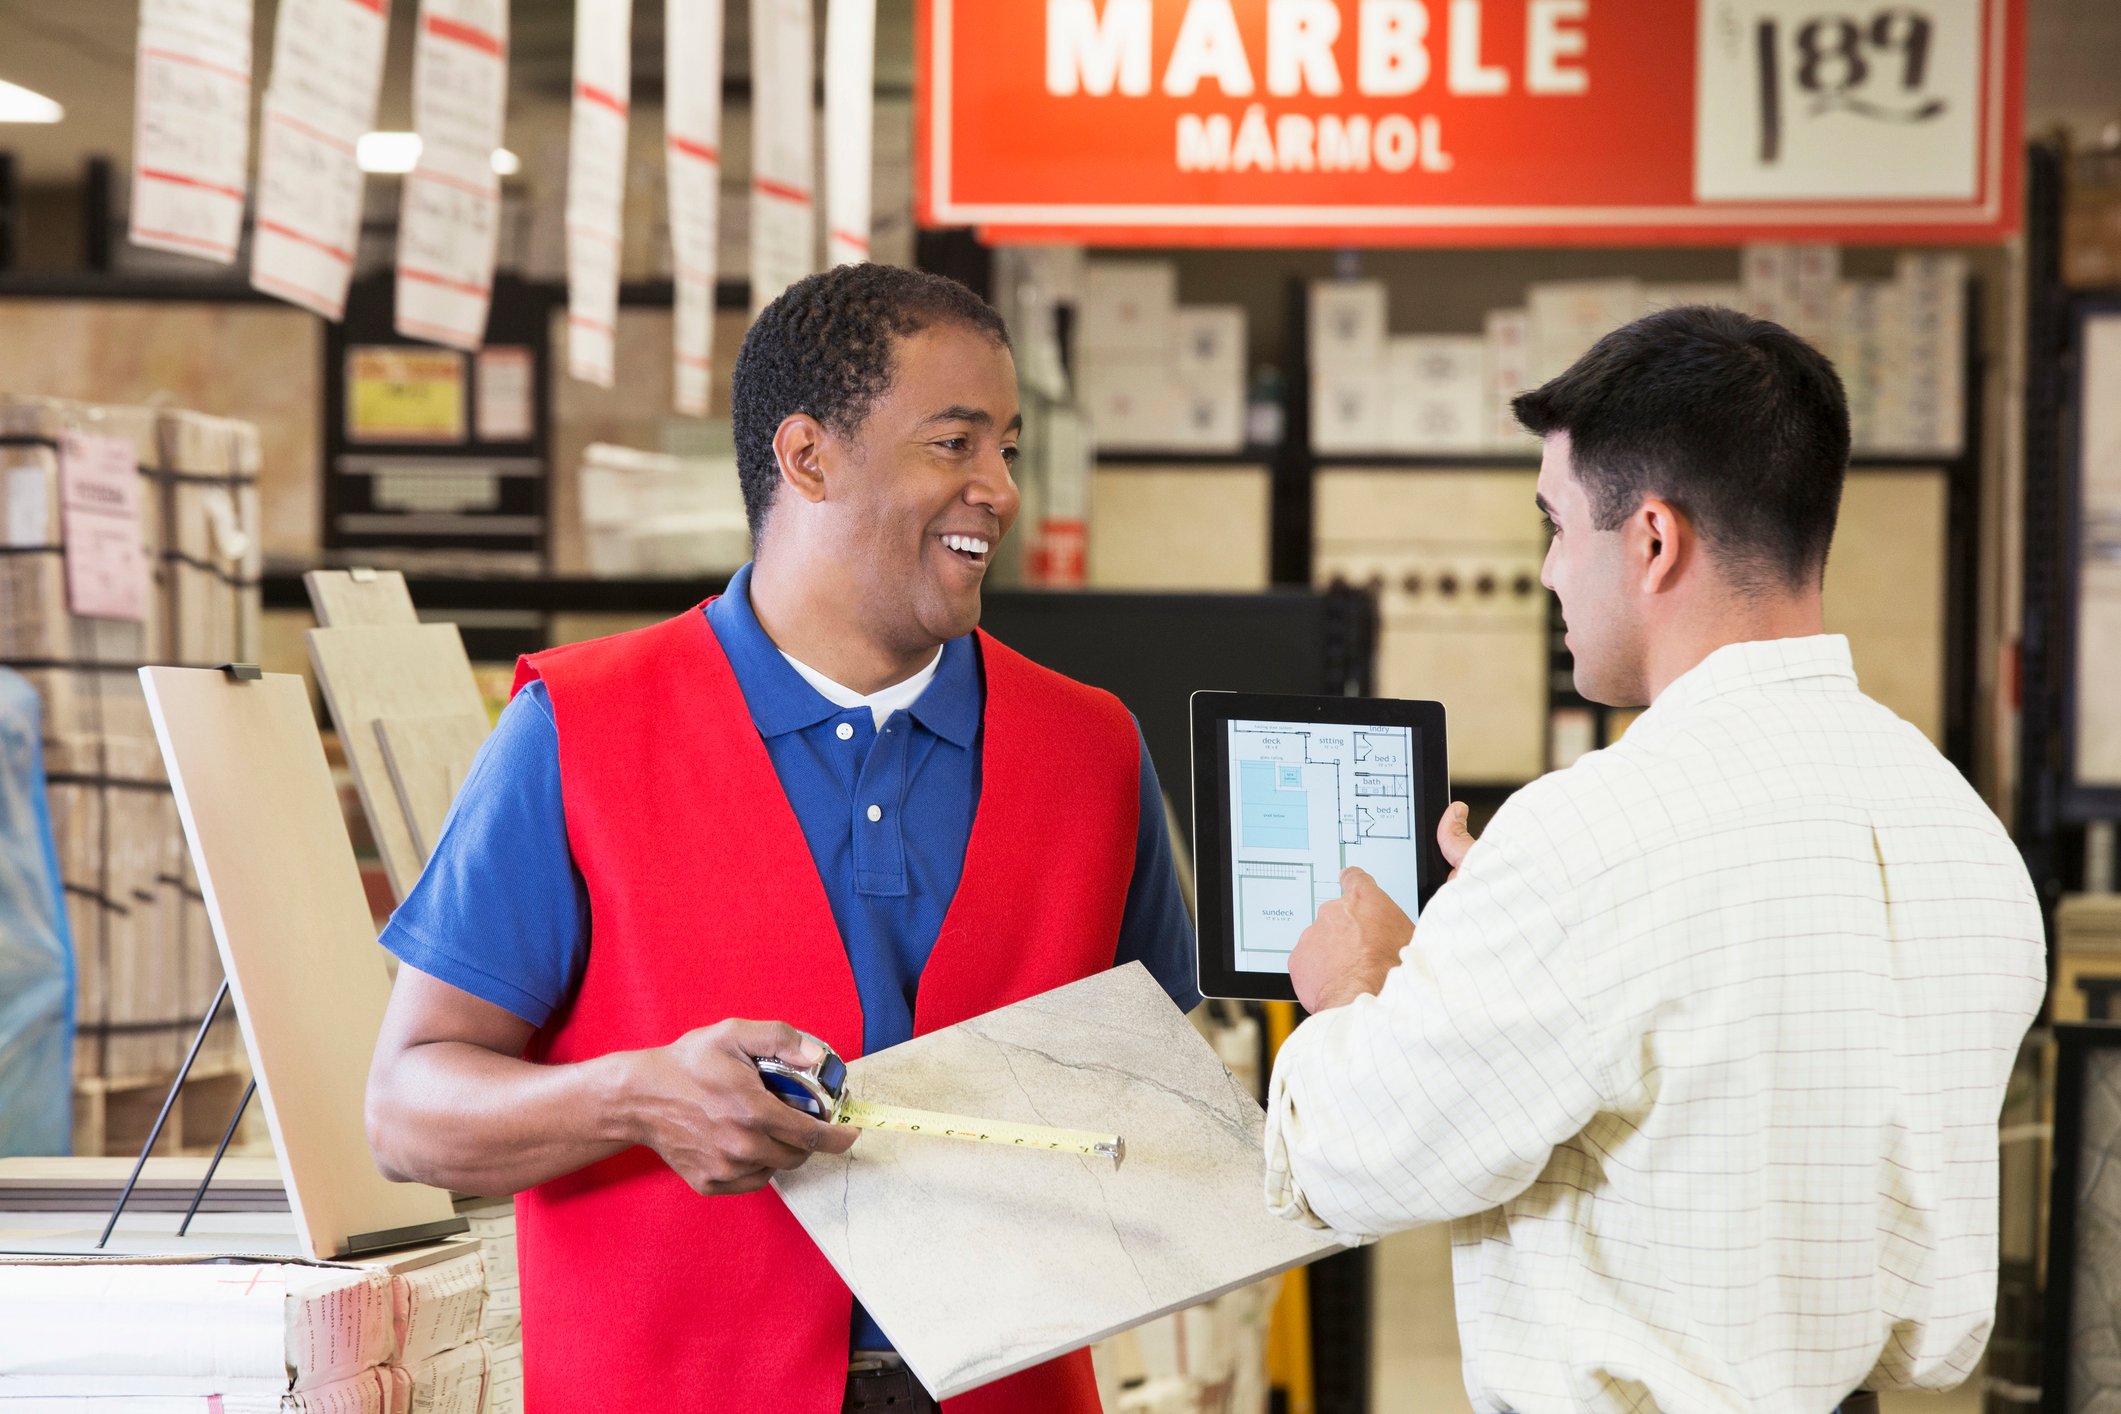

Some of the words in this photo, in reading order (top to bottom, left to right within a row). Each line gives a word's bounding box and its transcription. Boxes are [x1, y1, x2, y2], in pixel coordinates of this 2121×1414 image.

[1045, 0, 1591, 97] MARBLE
[1175, 102, 1455, 174] MÁRMOL
[1262, 737, 1281, 745] deck
[1319, 738, 1344, 746] sitting
[1392, 755, 1397, 763] 3
[1376, 806, 1392, 814] bed
[1262, 908, 1294, 917] sundeck
